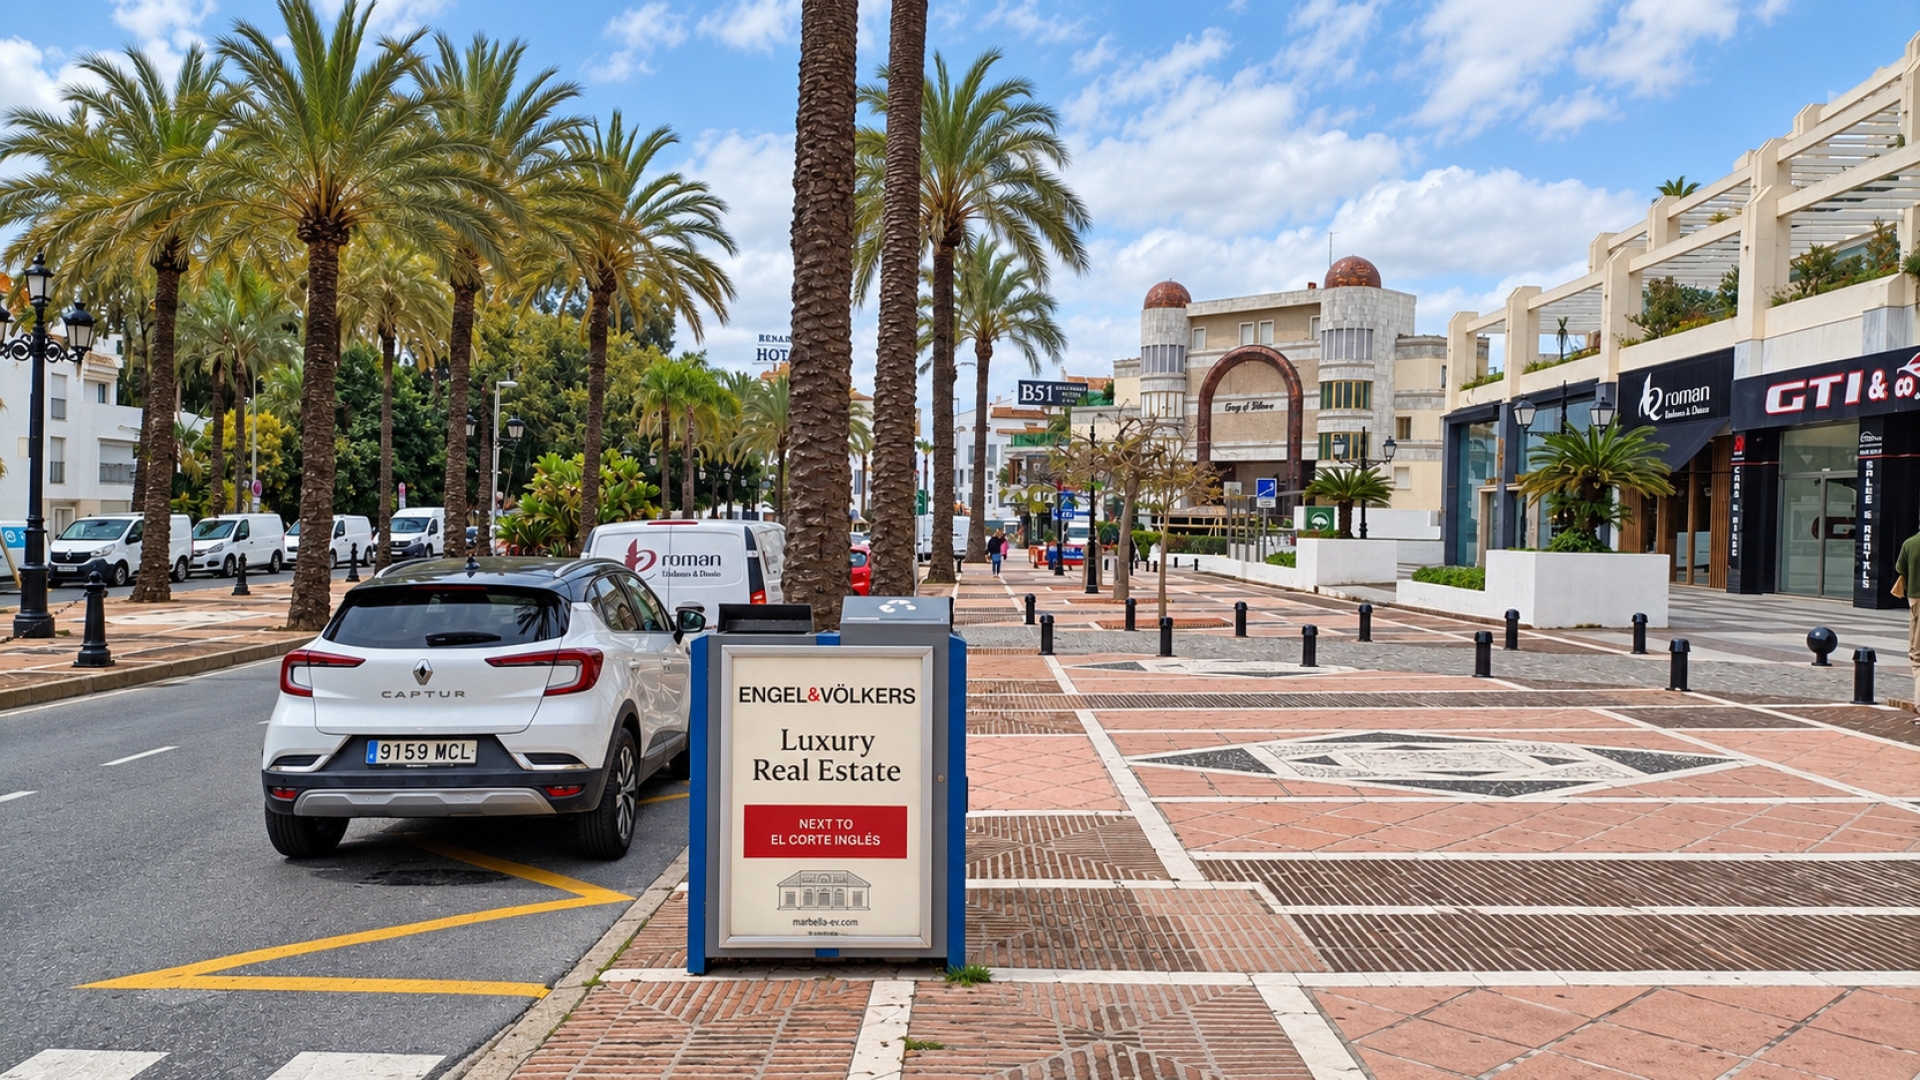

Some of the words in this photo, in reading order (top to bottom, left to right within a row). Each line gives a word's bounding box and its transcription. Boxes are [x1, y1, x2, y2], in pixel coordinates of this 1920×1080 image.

[756, 347, 790, 361] HOT
[1020, 384, 1053, 402] B51
[1665, 385, 1710, 407] roman
[1765, 369, 1865, 415] GTI
[1868, 368, 1888, 402] &
[662, 554, 721, 567] roman
[381, 691, 466, 699] CAPTUR
[739, 684, 916, 705] ENGEL&VÖLKERS
[380, 743, 429, 761] 9159
[434, 743, 471, 761] MCL
[781, 728, 876, 758] Luxury
[753, 758, 809, 782] Real
[818, 758, 902, 782] Estate
[799, 818, 833, 830] NEXT
[836, 818, 854, 830] TO
[771, 834, 786, 846] EL
[789, 834, 832, 846] CORTE
[834, 832, 881, 846] INGLÉS
[792, 917, 859, 927] marbella-ev.com
